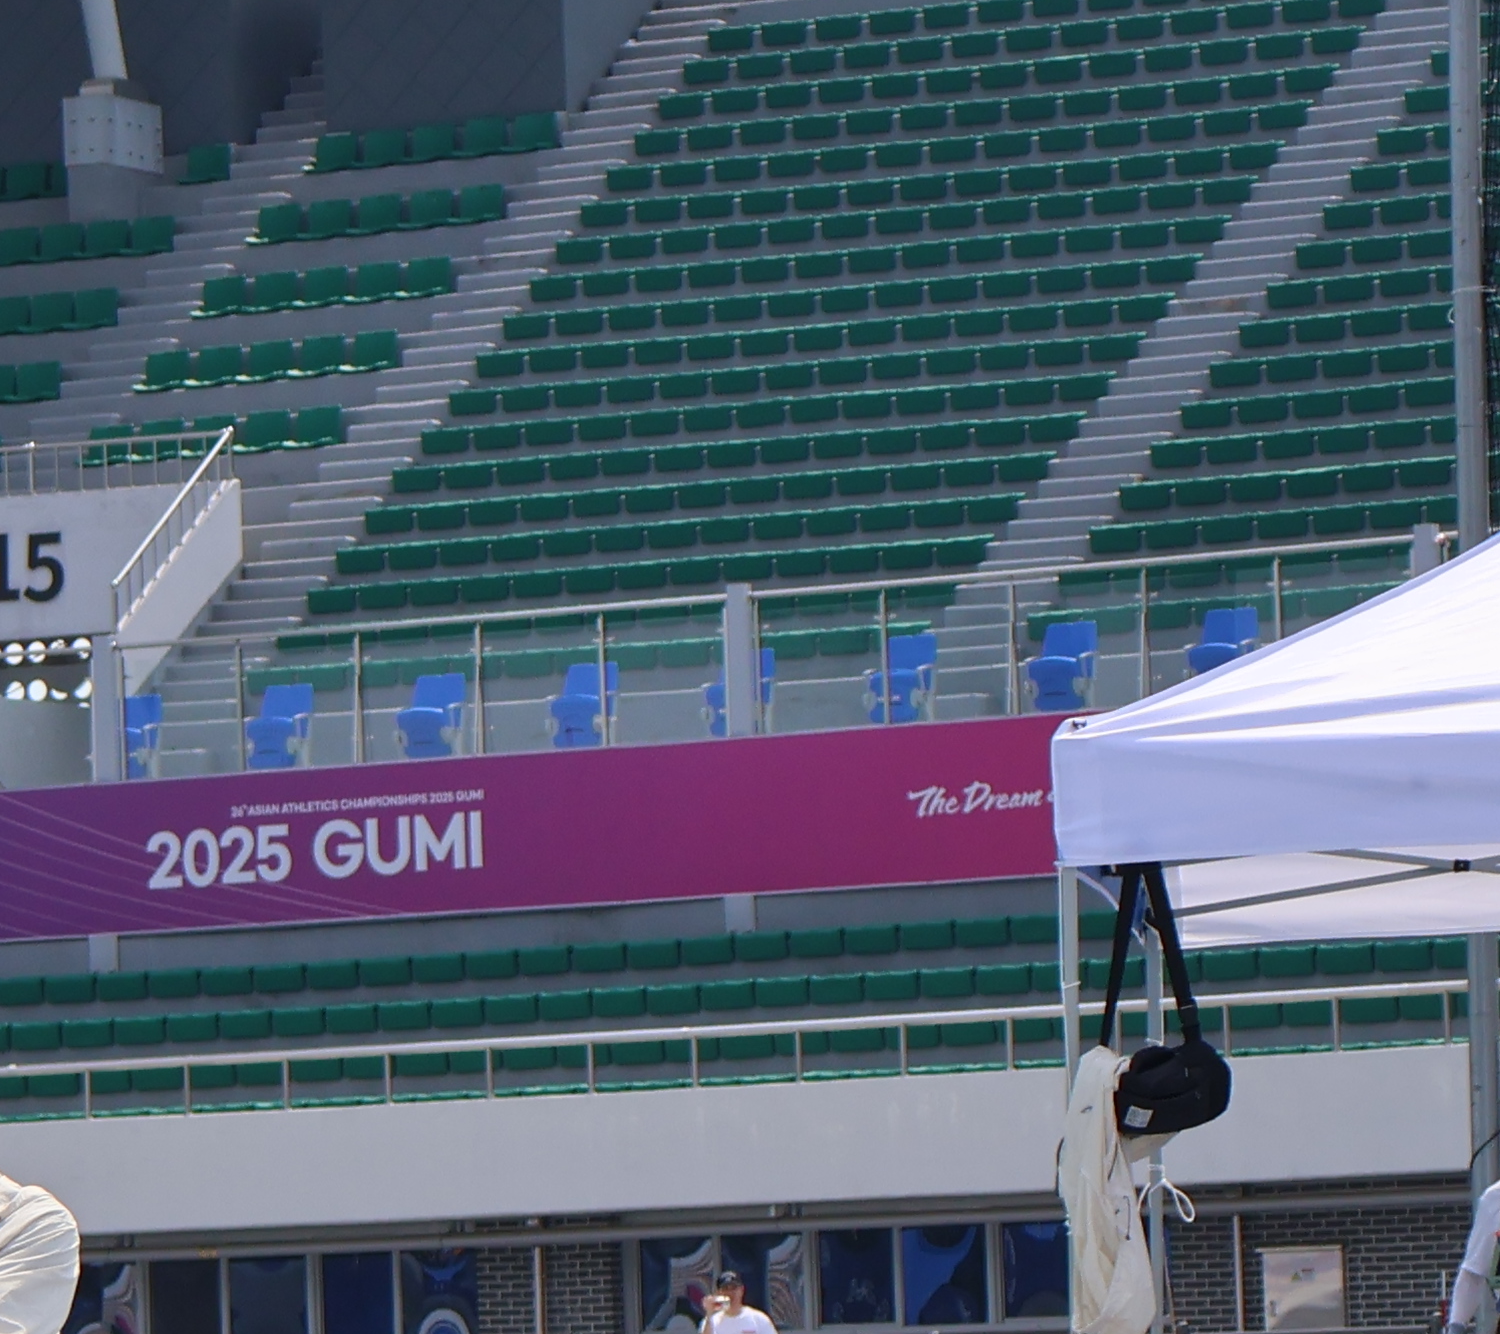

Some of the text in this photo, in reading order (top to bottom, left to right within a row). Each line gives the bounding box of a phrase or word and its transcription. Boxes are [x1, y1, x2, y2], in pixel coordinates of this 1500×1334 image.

[247, 804, 280, 817] ASIAN
[281, 799, 339, 815] ATHLETICS
[340, 793, 428, 810] CHAMPIONSHIPS
[429, 791, 455, 804] 2025
[457, 788, 485, 802] GUMI
[907, 784, 960, 818] The
[963, 779, 1043, 814] Dream
[147, 811, 484, 889] 2025 GUMI
